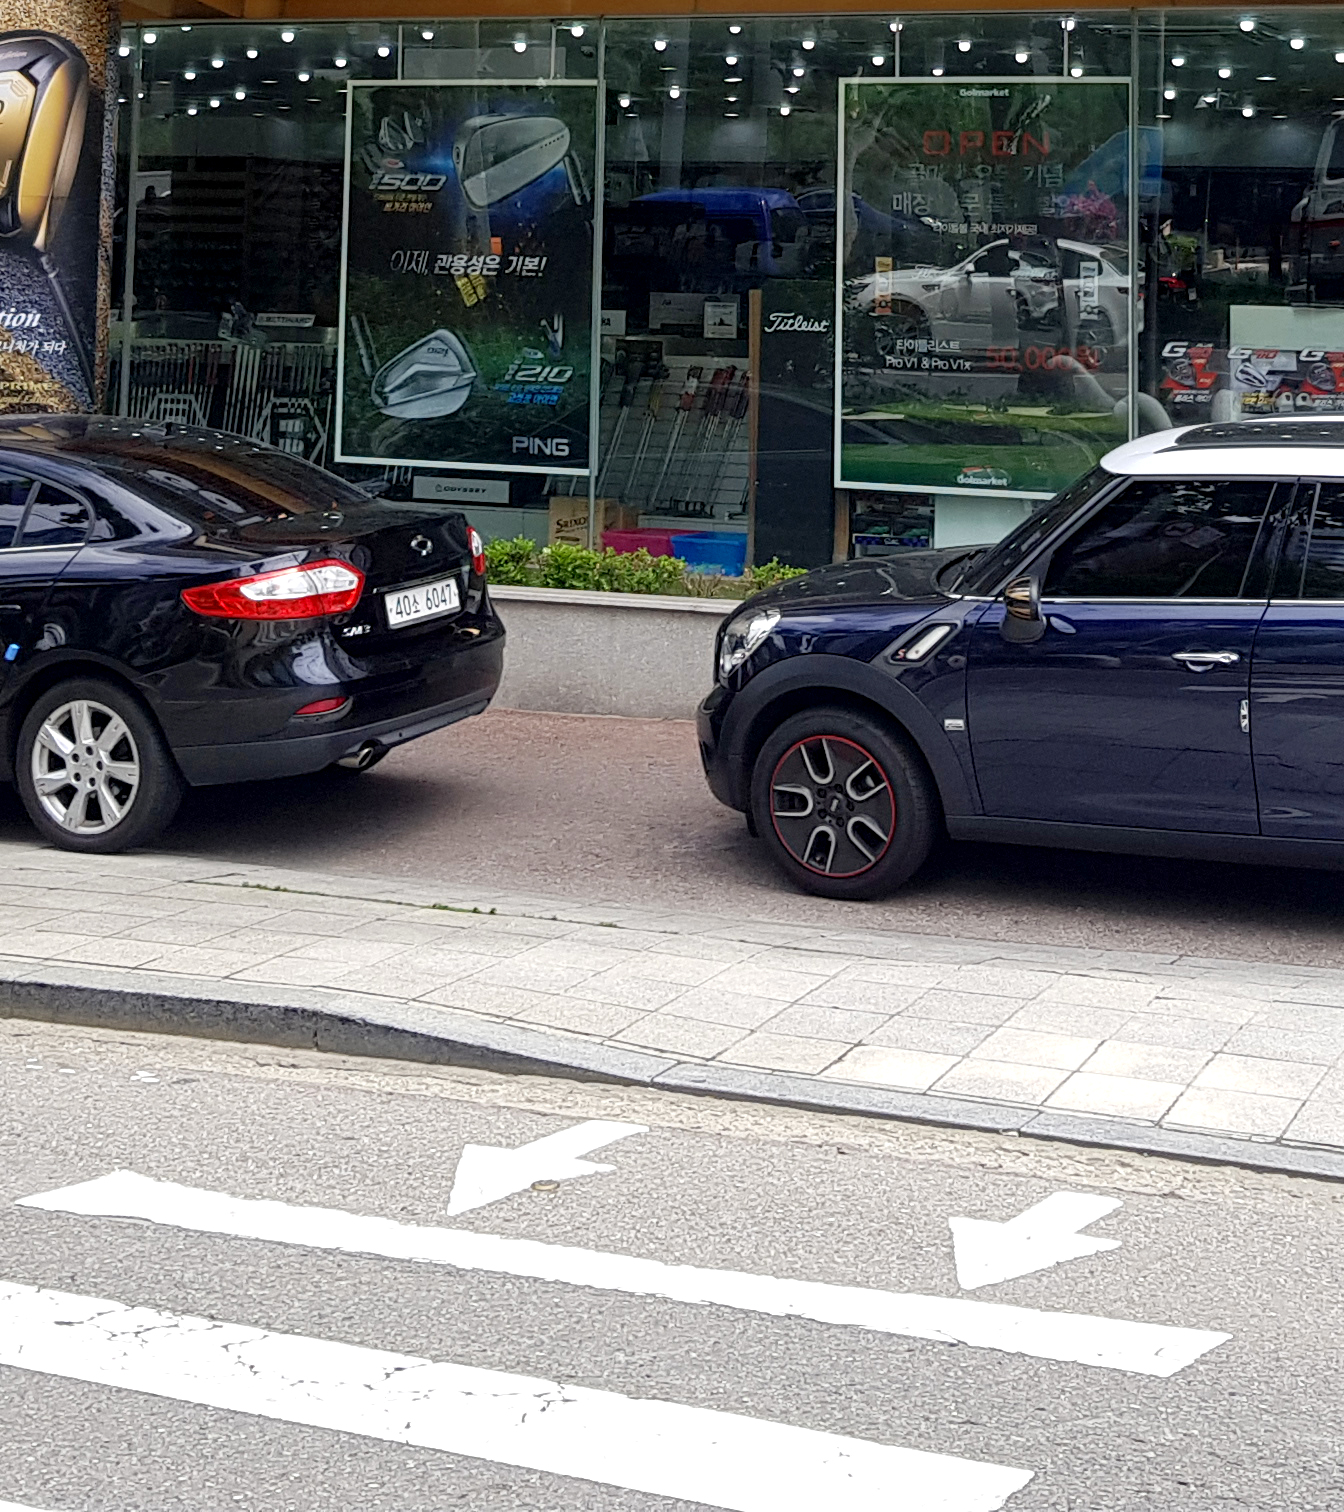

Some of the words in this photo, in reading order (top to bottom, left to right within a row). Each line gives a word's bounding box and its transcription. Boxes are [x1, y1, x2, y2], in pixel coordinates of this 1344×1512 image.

[922, 130, 1051, 156] OPEN
[434, 255, 500, 275] 관용성은
[505, 255, 548, 276] 기본!
[764, 312, 830, 333] Titleist
[41, 340, 67, 355] 되다
[896, 339, 960, 352] 타이틀리스트
[886, 357, 902, 368] Pro
[921, 357, 929, 368] &
[931, 358, 949, 369] Pro
[512, 436, 570, 456] PING
[556, 516, 588, 531] SRIXO
[396, 594, 421, 618] 40소
[426, 584, 452, 610] 6047
